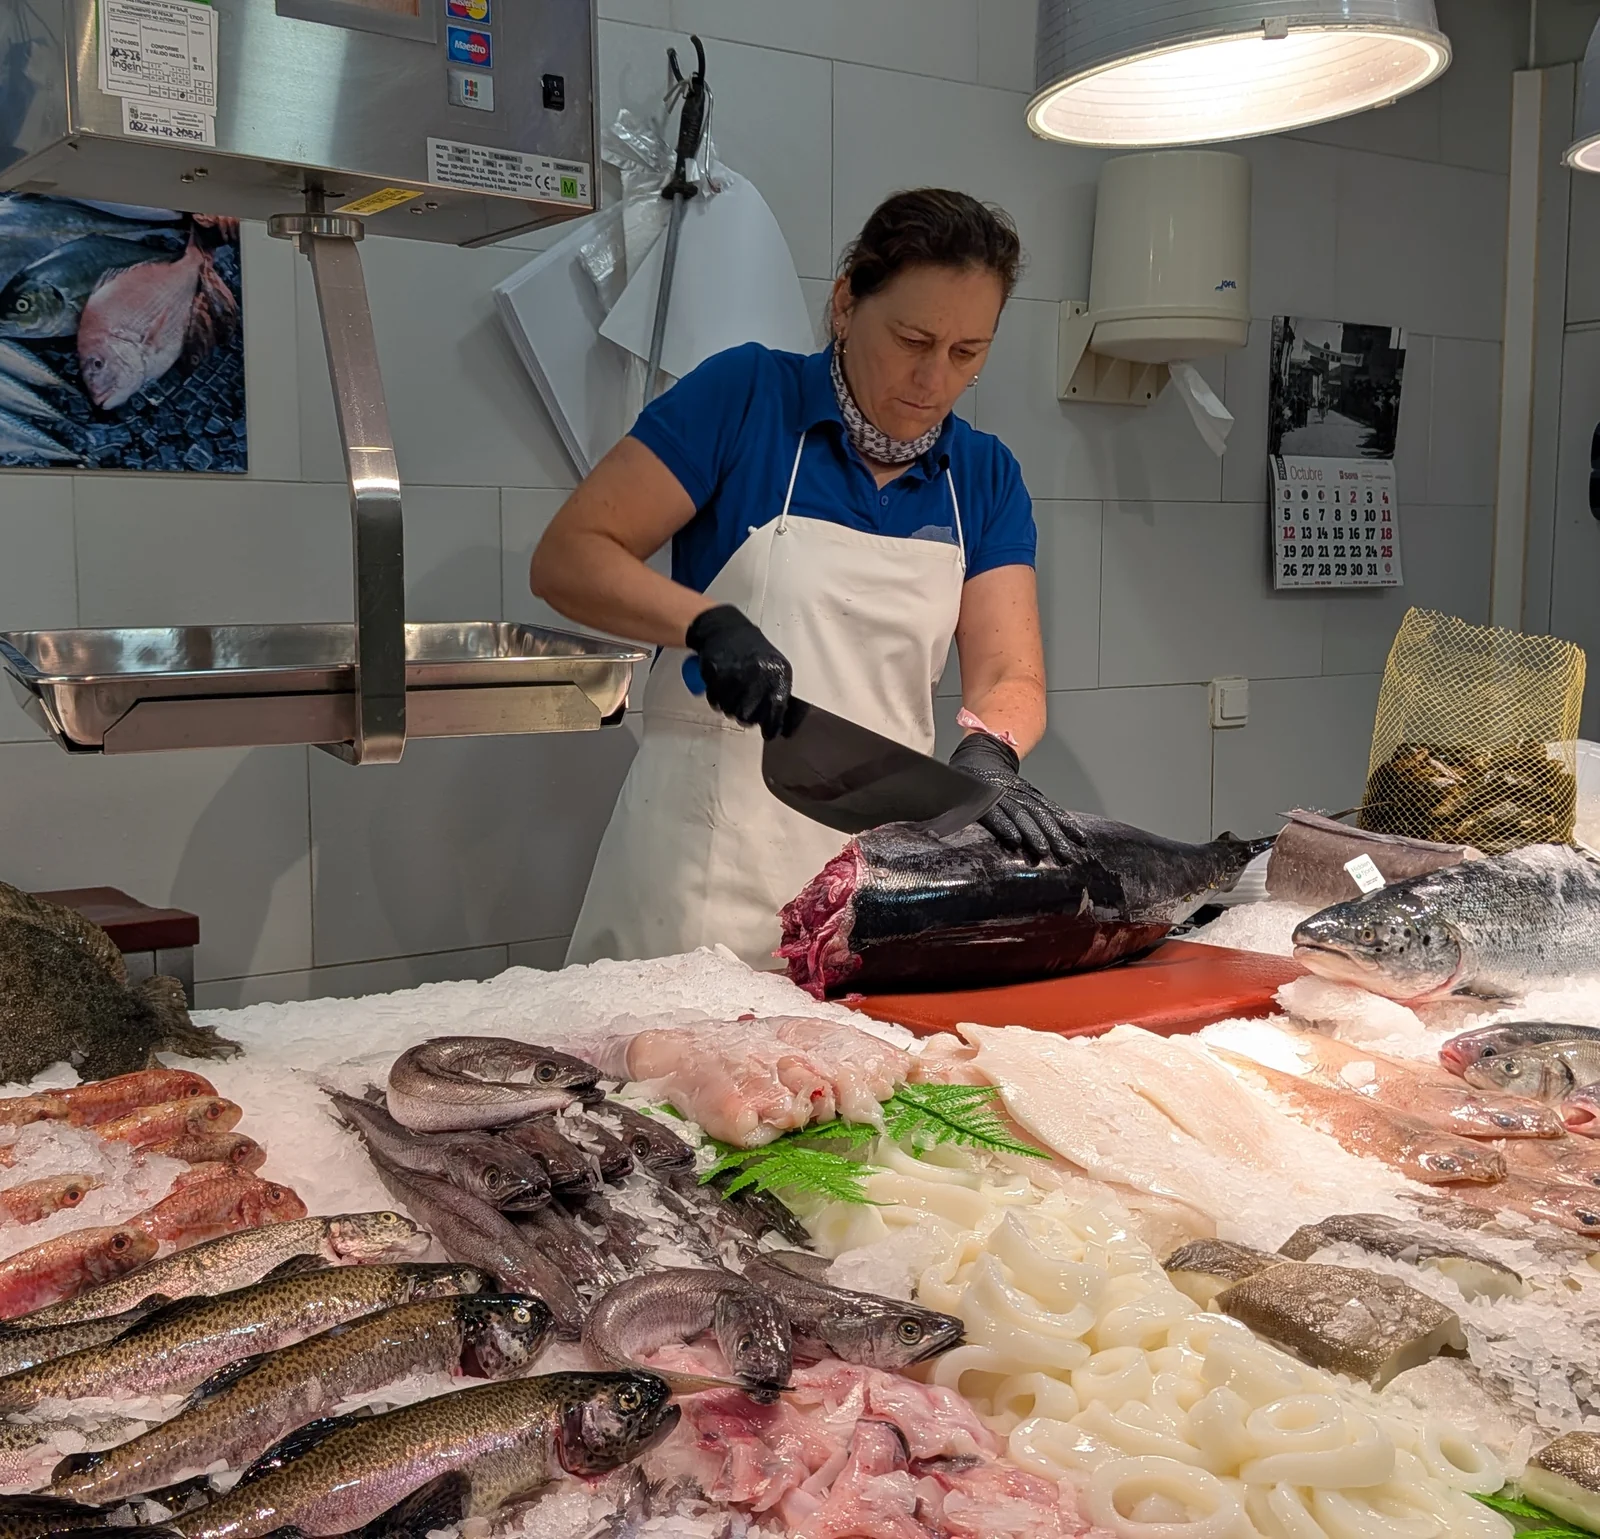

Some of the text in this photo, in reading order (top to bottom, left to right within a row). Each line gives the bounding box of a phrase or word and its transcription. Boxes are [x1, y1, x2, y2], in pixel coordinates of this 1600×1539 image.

[151, 43, 179, 52] CONFORME
[454, 40, 486, 54] Maestro
[150, 48, 168, 57] VÁLIDO
[168, 52, 185, 60] HASTA
[112, 58, 141, 72] ingein
[563, 185, 574, 194] M
[1290, 466, 1322, 480] Octubre
[1335, 491, 1388, 504] 1 2 3 4
[1284, 508, 1391, 522] 5 6 7 8 9 10 11
[1283, 527, 1392, 540] 12 13 14 15 16 17 18
[1284, 546, 1392, 557] 19 20 21 22 23 24 25
[1284, 563, 1377, 576] 26 27 28 29 30 31
[1351, 861, 1370, 872] Hidden
